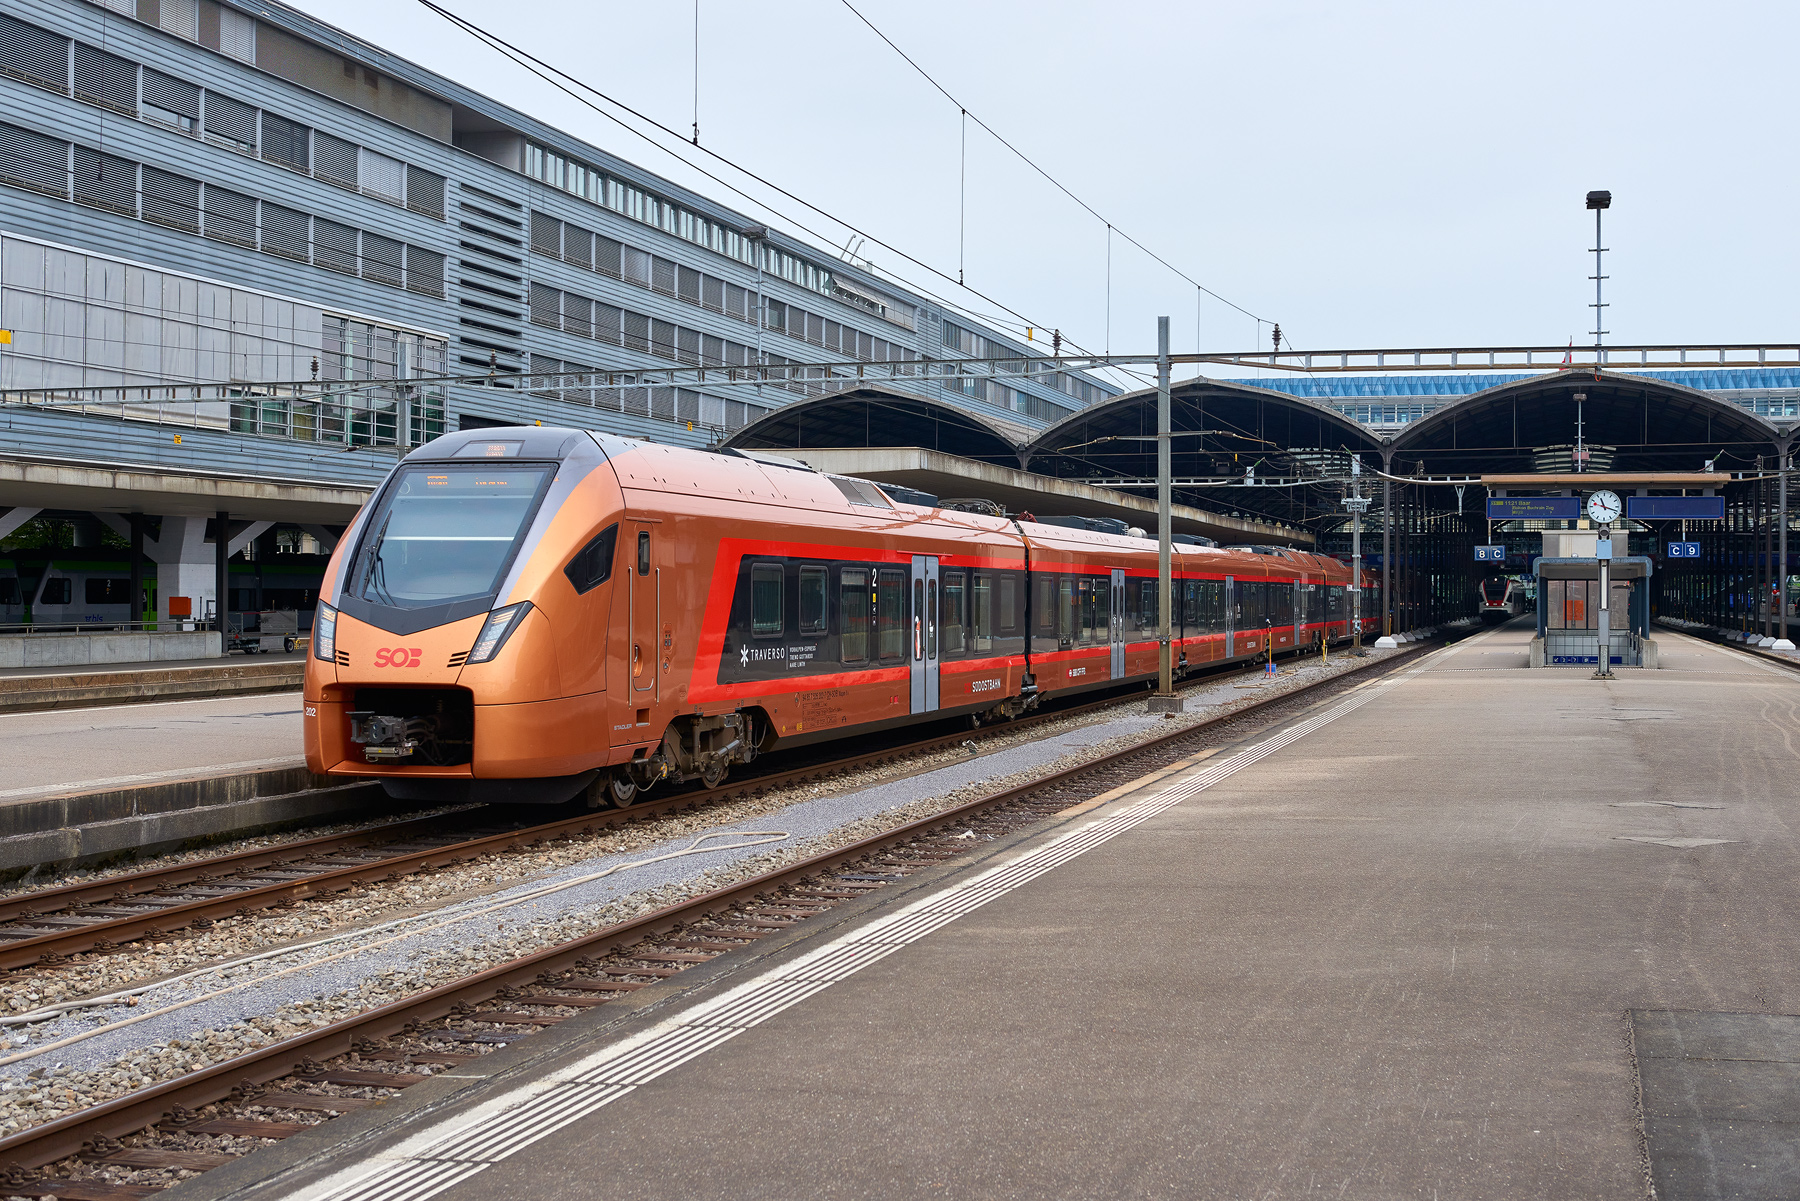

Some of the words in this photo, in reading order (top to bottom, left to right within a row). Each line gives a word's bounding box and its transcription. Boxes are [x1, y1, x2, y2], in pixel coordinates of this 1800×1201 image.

[1479, 550, 1485, 558] 8
[1494, 550, 1501, 558] C
[1672, 546, 1680, 555] C
[1688, 546, 1695, 555] 9
[872, 567, 877, 587] 2
[1092, 578, 1096, 591] 2
[373, 647, 423, 668] SOB
[750, 648, 785, 660] TRAVERSO
[306, 707, 316, 716] 202
